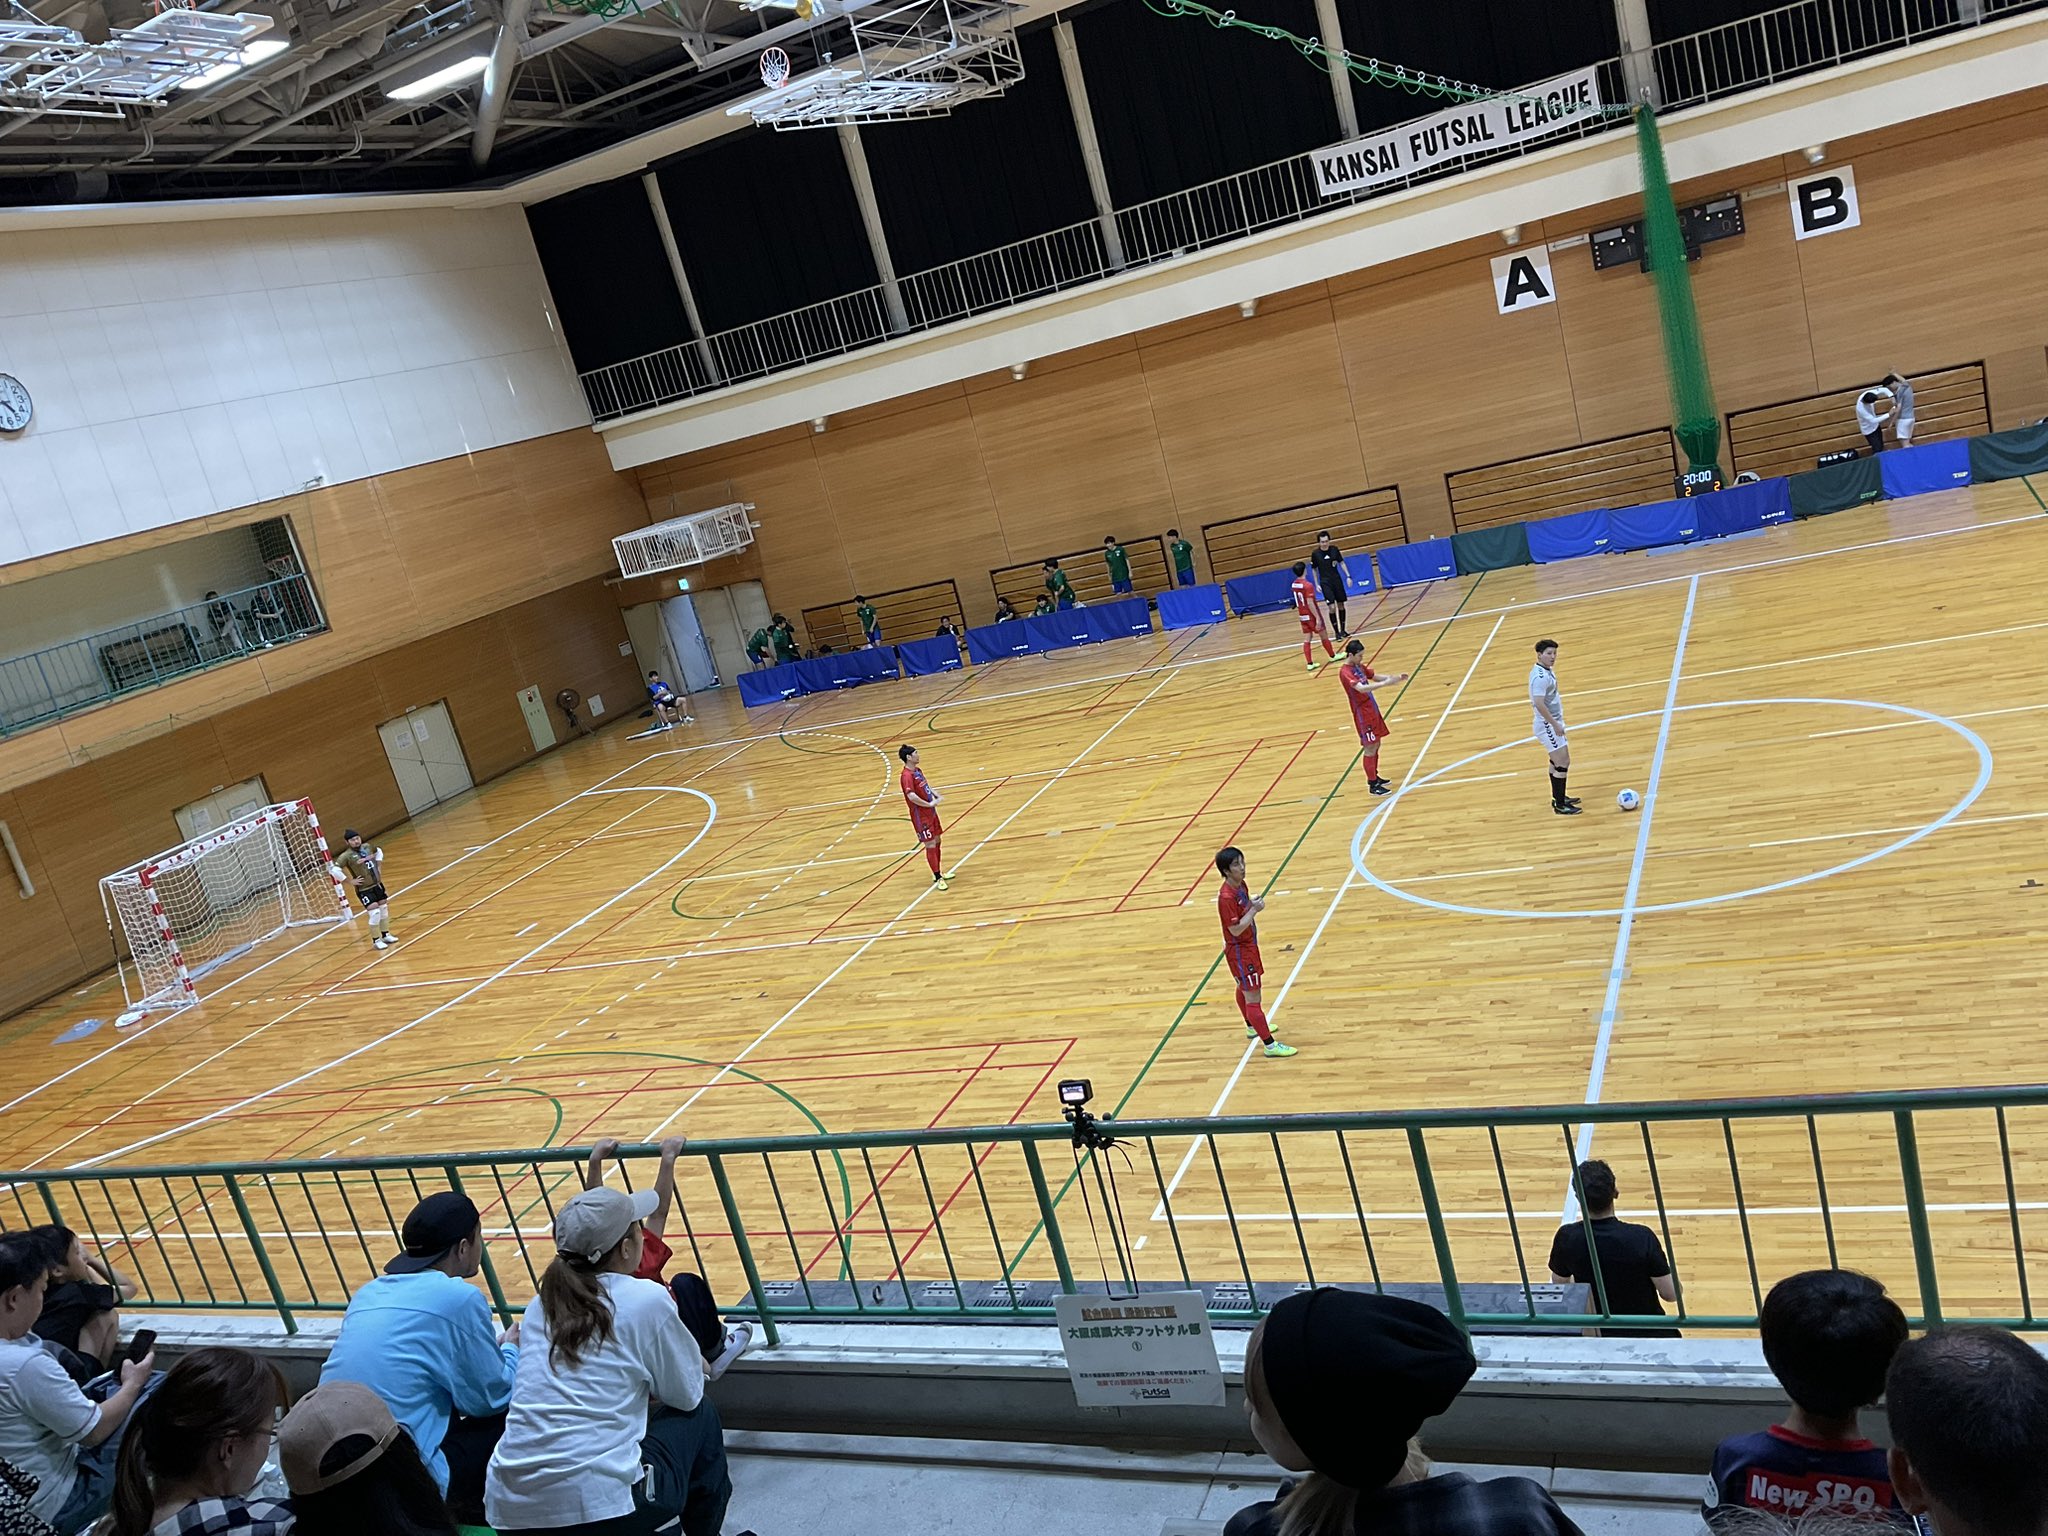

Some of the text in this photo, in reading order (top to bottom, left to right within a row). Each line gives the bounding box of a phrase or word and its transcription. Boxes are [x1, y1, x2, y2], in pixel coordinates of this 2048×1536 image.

[1320, 79, 1593, 186] KANSAI FUTSAL LEAGUE
[1796, 176, 1849, 233] B
[1503, 256, 1550, 307] A
[1683, 470, 1712, 486] 20:00
[1685, 487, 1692, 497] 2
[1714, 480, 1721, 492] 2
[1366, 731, 1376, 742] 16
[923, 829, 932, 840] 15
[1247, 972, 1260, 987] 17
[1751, 1475, 1809, 1508] New
